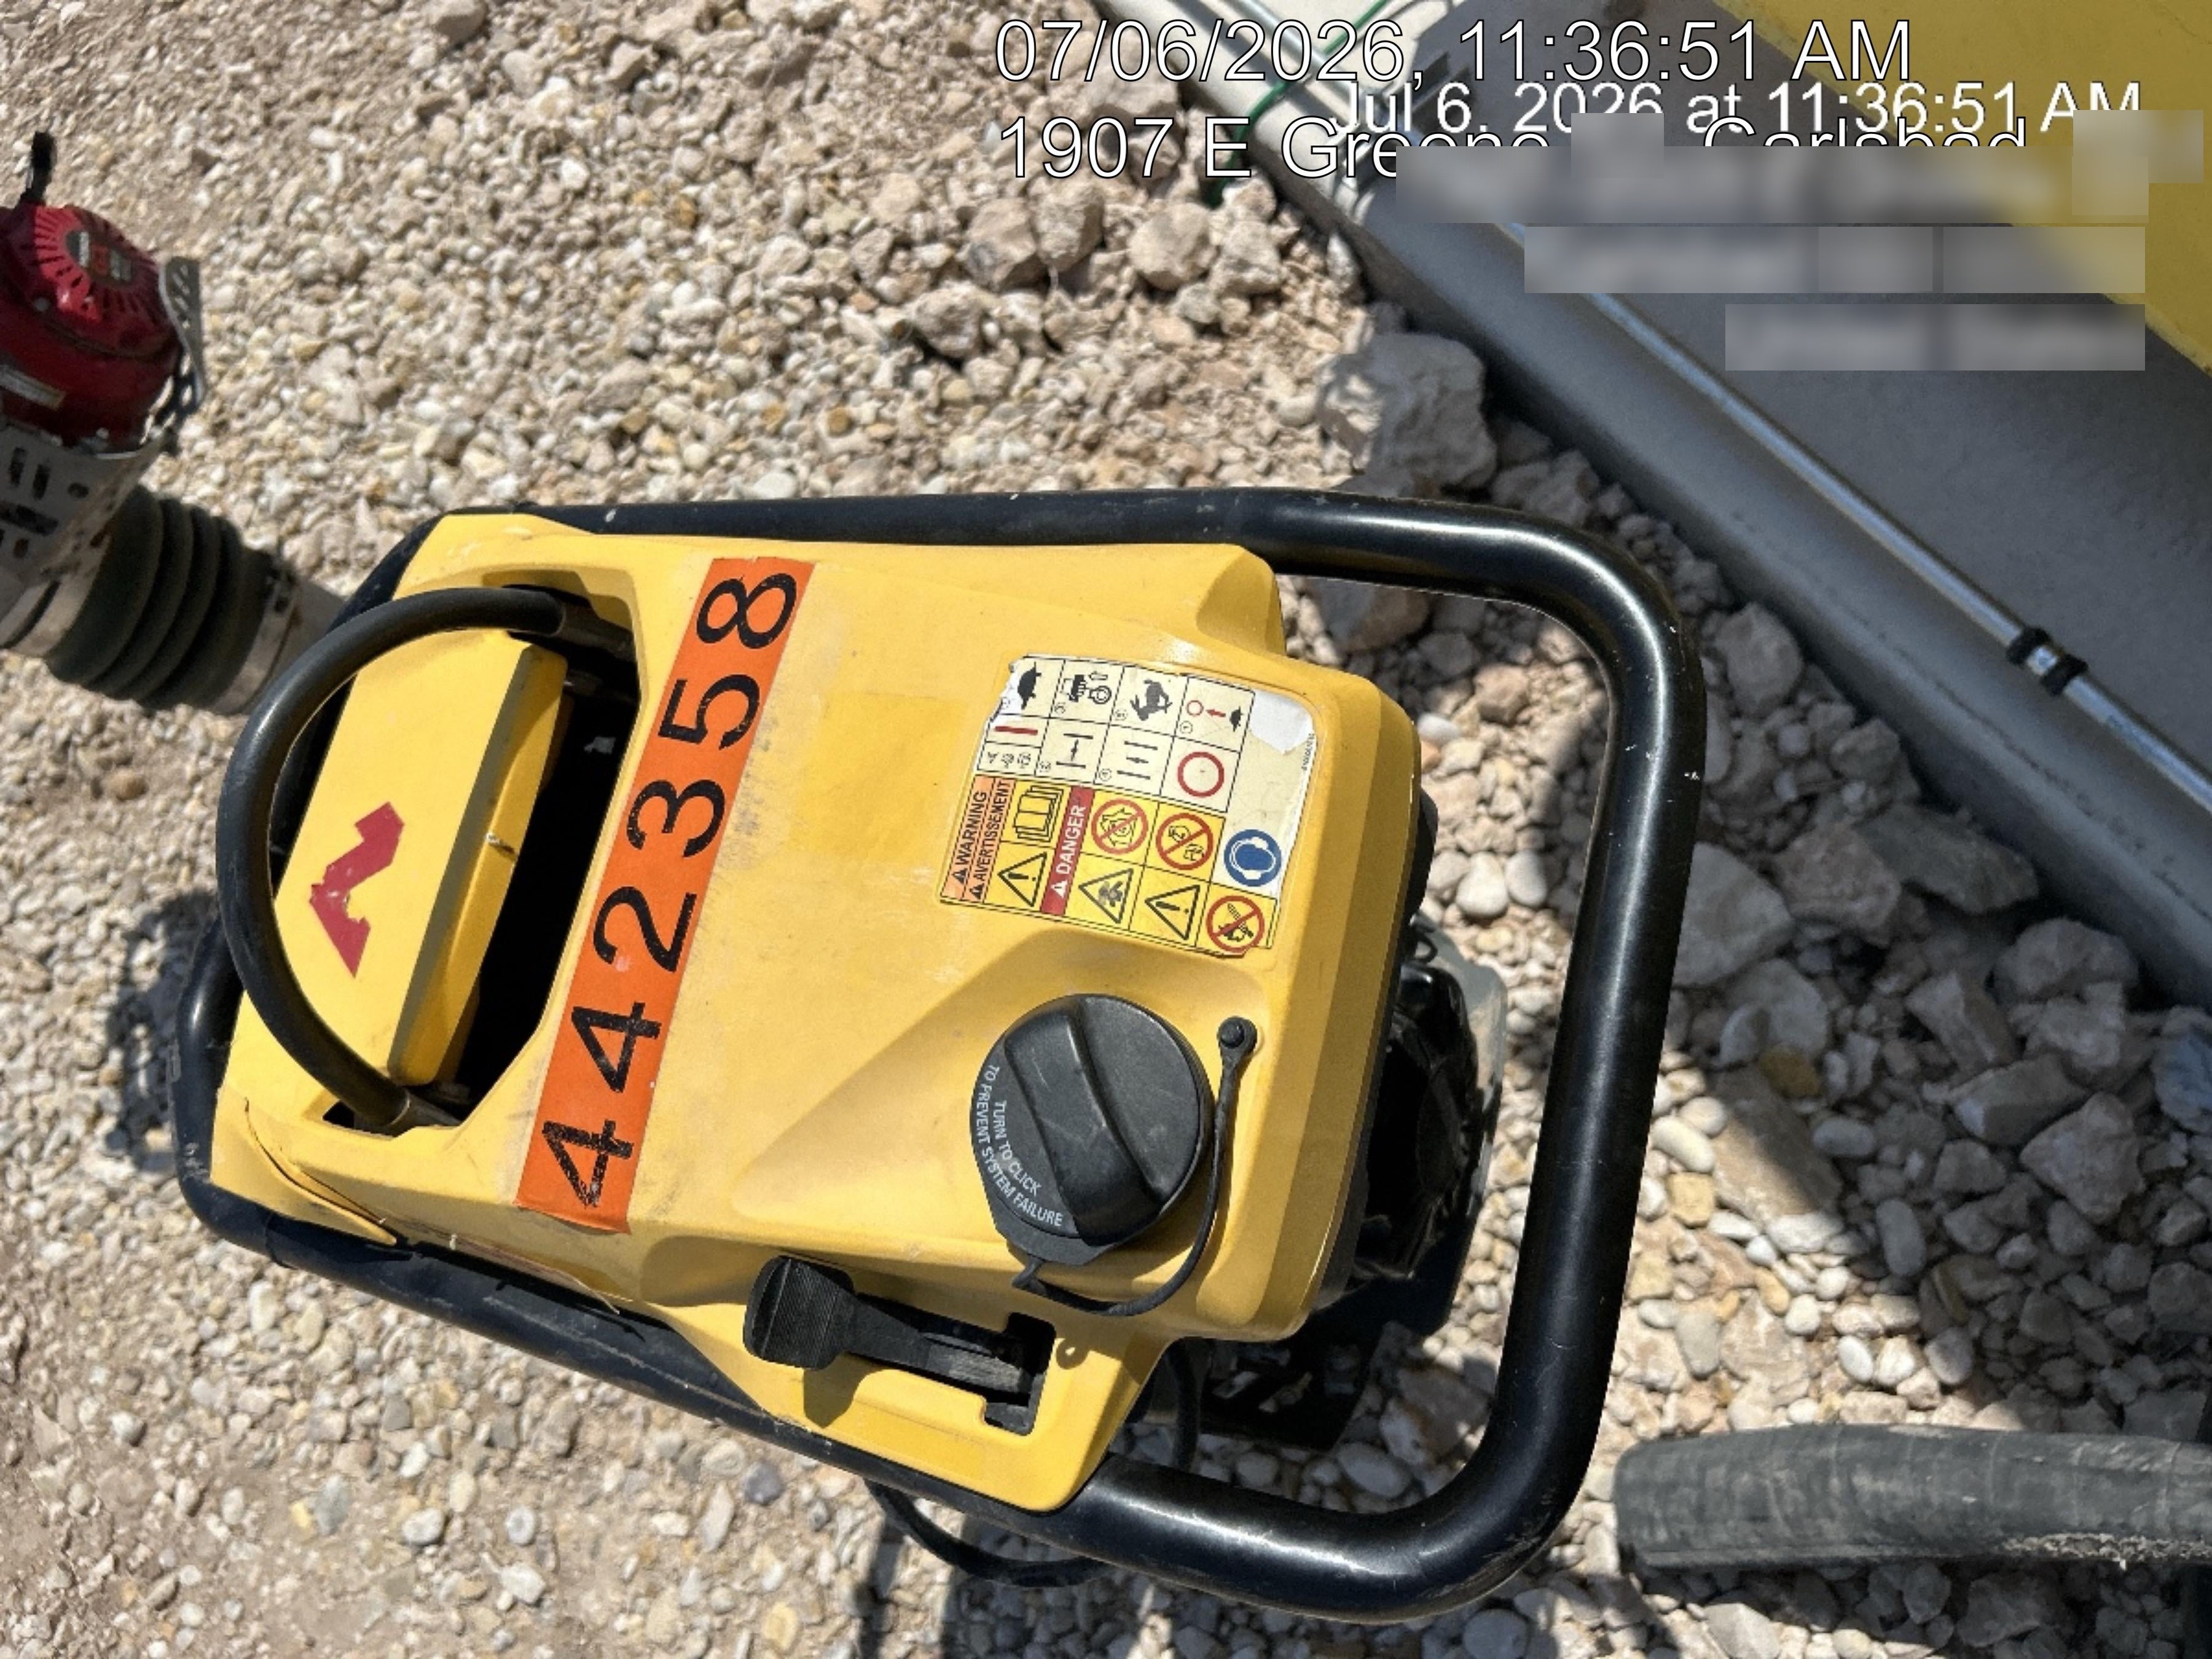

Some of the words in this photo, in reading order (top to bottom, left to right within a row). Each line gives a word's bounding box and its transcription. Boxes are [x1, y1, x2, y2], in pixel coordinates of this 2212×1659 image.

[954, 791, 987, 866] WARNING
[973, 779, 1011, 882] AVERTISSEMENT
[1056, 804, 1087, 875] DANGER
[542, 571, 798, 1209] 442358
[985, 1064, 1000, 1082] TO
[976, 1083, 993, 1144] PREVENT
[993, 1100, 1007, 1140] TURN
[982, 1146, 1017, 1198] SYSTEM
[998, 1140, 1013, 1161] TO
[1008, 1161, 1042, 1197] CLICK
[1013, 1191, 1064, 1227] FAILURE
